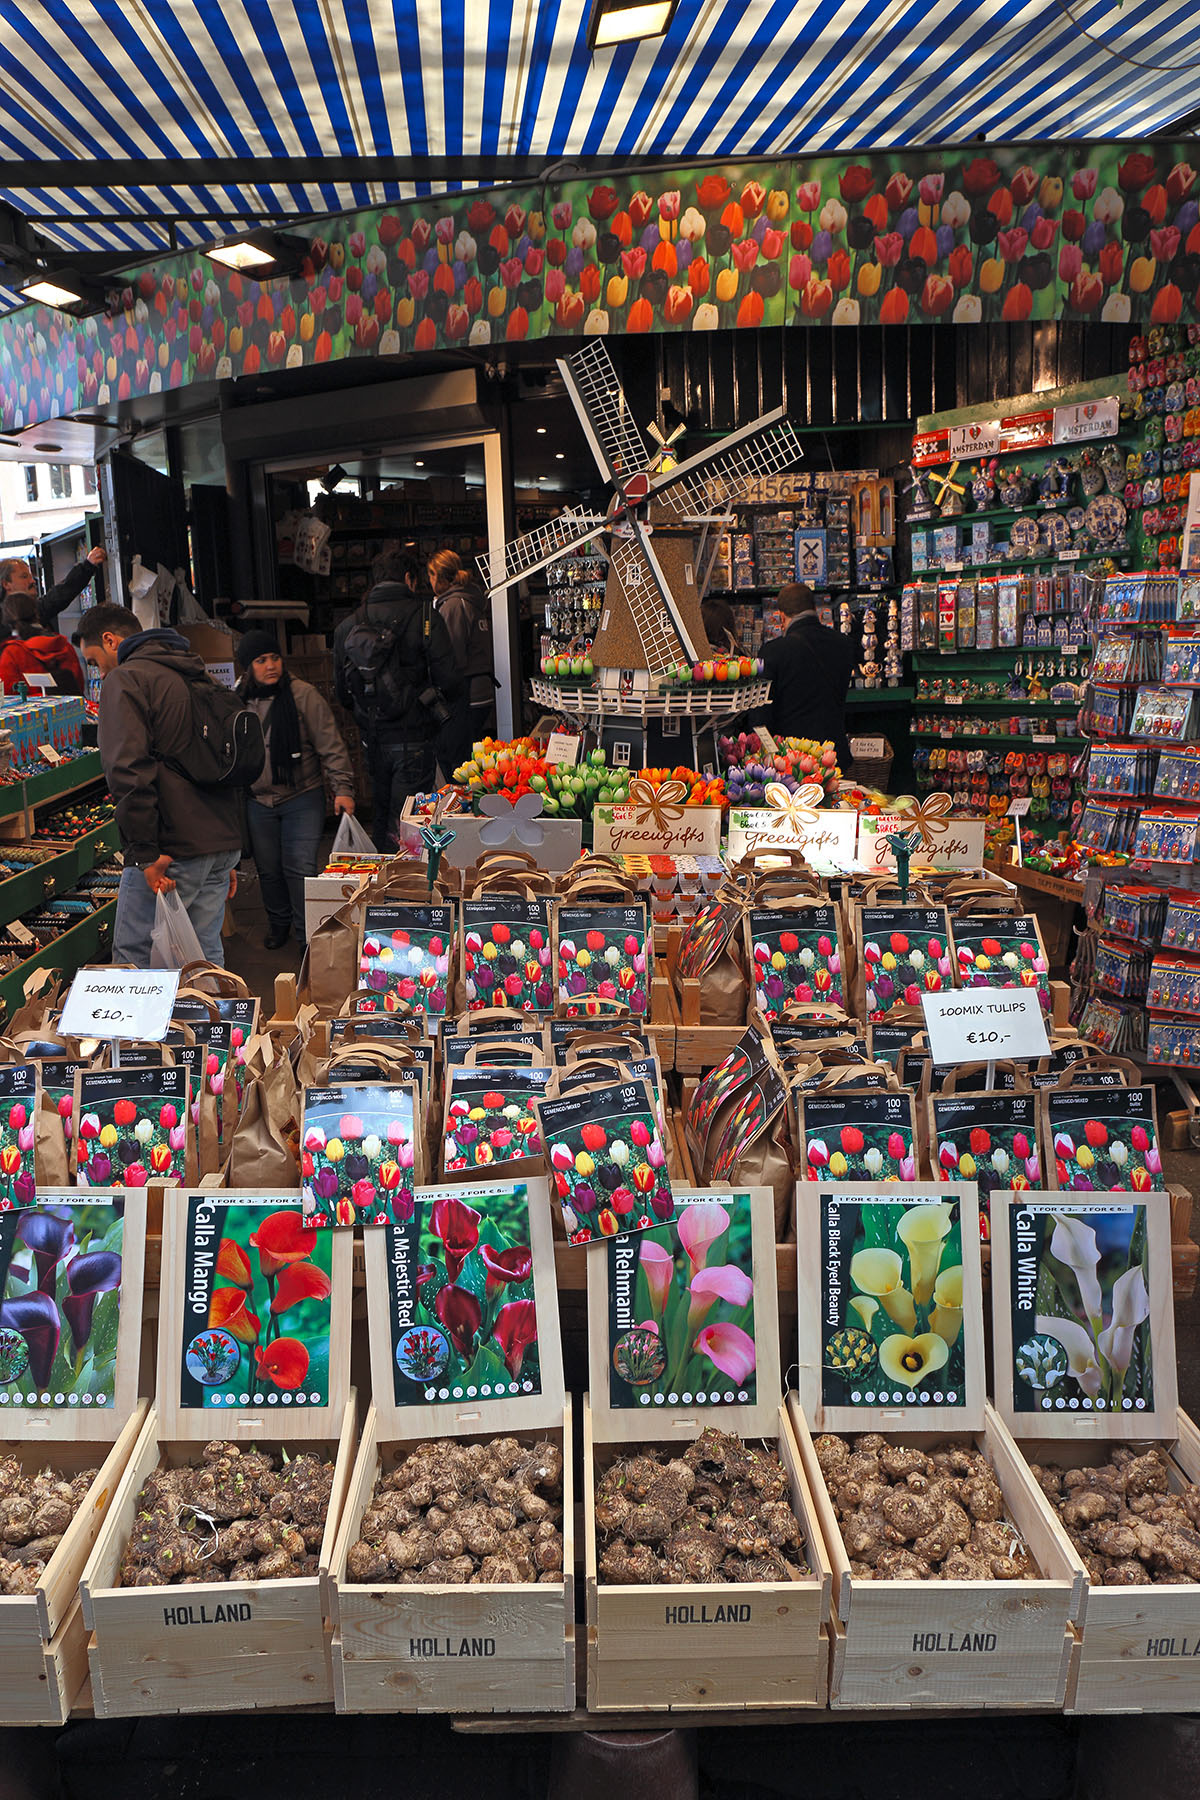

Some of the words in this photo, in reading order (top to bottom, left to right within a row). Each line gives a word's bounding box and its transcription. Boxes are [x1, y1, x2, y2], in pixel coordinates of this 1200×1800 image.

[1074, 408, 1079, 423] I
[962, 429, 966, 443] I
[952, 440, 994, 454] AMSTERDAM
[750, 480, 763, 499] 4
[765, 479, 779, 498] 5
[779, 479, 792, 498] 6
[609, 826, 704, 851] Greengifts
[745, 831, 840, 851] Greengifts
[875, 836, 968, 864] Gngifts
[84, 984, 124, 994] 100MIX
[129, 985, 164, 995] TULIPS
[235, 1002, 248, 1010] 100
[939, 1005, 983, 1017] 100MIX
[987, 1002, 1026, 1013] TULIPS
[91, 1009, 133, 1022] €10,-
[210, 1026, 223, 1034] 100
[966, 1031, 1011, 1043] €10,-
[181, 1051, 195, 1059] 100
[1063, 1051, 1076, 1059] 100
[12, 1070, 27, 1080] 100
[65, 1065, 79, 1073] 100
[161, 1071, 177, 1080] 100
[529, 1071, 543, 1080] 100
[632, 1063, 647, 1073] 100
[1100, 1076, 1114, 1084] 100
[388, 1090, 403, 1099] 100
[620, 1086, 636, 1098] 100
[1127, 1092, 1143, 1101] 100
[885, 1098, 901, 1107] 100
[1011, 1099, 1026, 1108] 100
[828, 1201, 840, 1227] Calla
[194, 1202, 216, 1246] Calla
[1016, 1210, 1036, 1253] Calla
[828, 1229, 841, 1258] Black
[391, 1238, 411, 1297] Majestic
[826, 1260, 841, 1288] Eyed
[188, 1251, 214, 1314] Mango
[615, 1248, 635, 1329] Rehmanii
[1017, 1257, 1037, 1310] White
[397, 1300, 415, 1327] Red
[826, 1288, 841, 1327] Beauty
[163, 1603, 251, 1626] HOLLAND
[665, 1604, 751, 1624] HOLLAND
[409, 1637, 496, 1657] HOLLAND
[912, 1633, 997, 1652] HOLLAND
